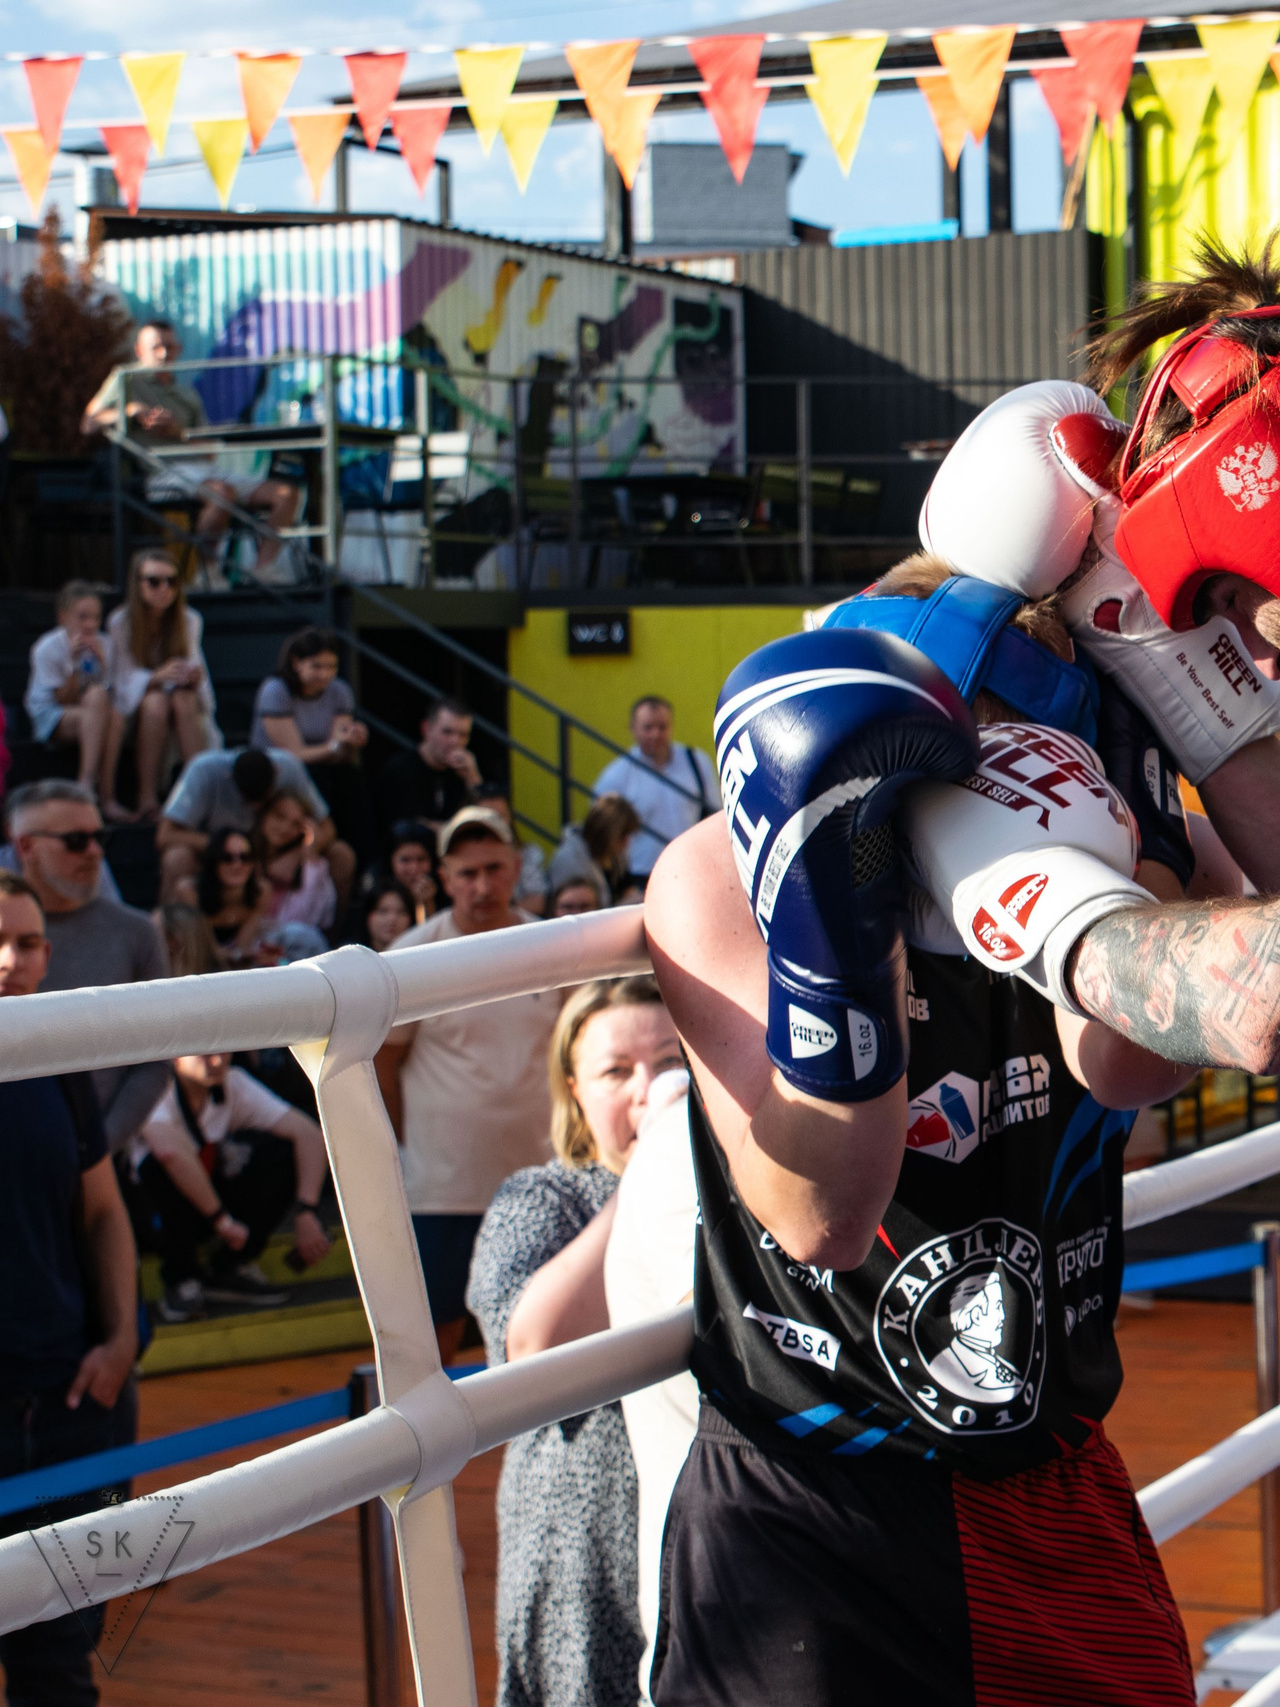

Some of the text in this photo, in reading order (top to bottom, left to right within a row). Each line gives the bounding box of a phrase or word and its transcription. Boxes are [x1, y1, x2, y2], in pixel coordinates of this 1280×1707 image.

[1208, 642, 1242, 696] HILL
[1217, 633, 1262, 693] GREEN
[1176, 652, 1235, 730] Be Your Best Self
[964, 774, 1020, 804] EST SELF
[981, 741, 1072, 810] ILL
[787, 1266, 821, 1292] GIN
[766, 1320, 831, 1361] TBSA
[916, 1382, 1035, 1426] 2010
